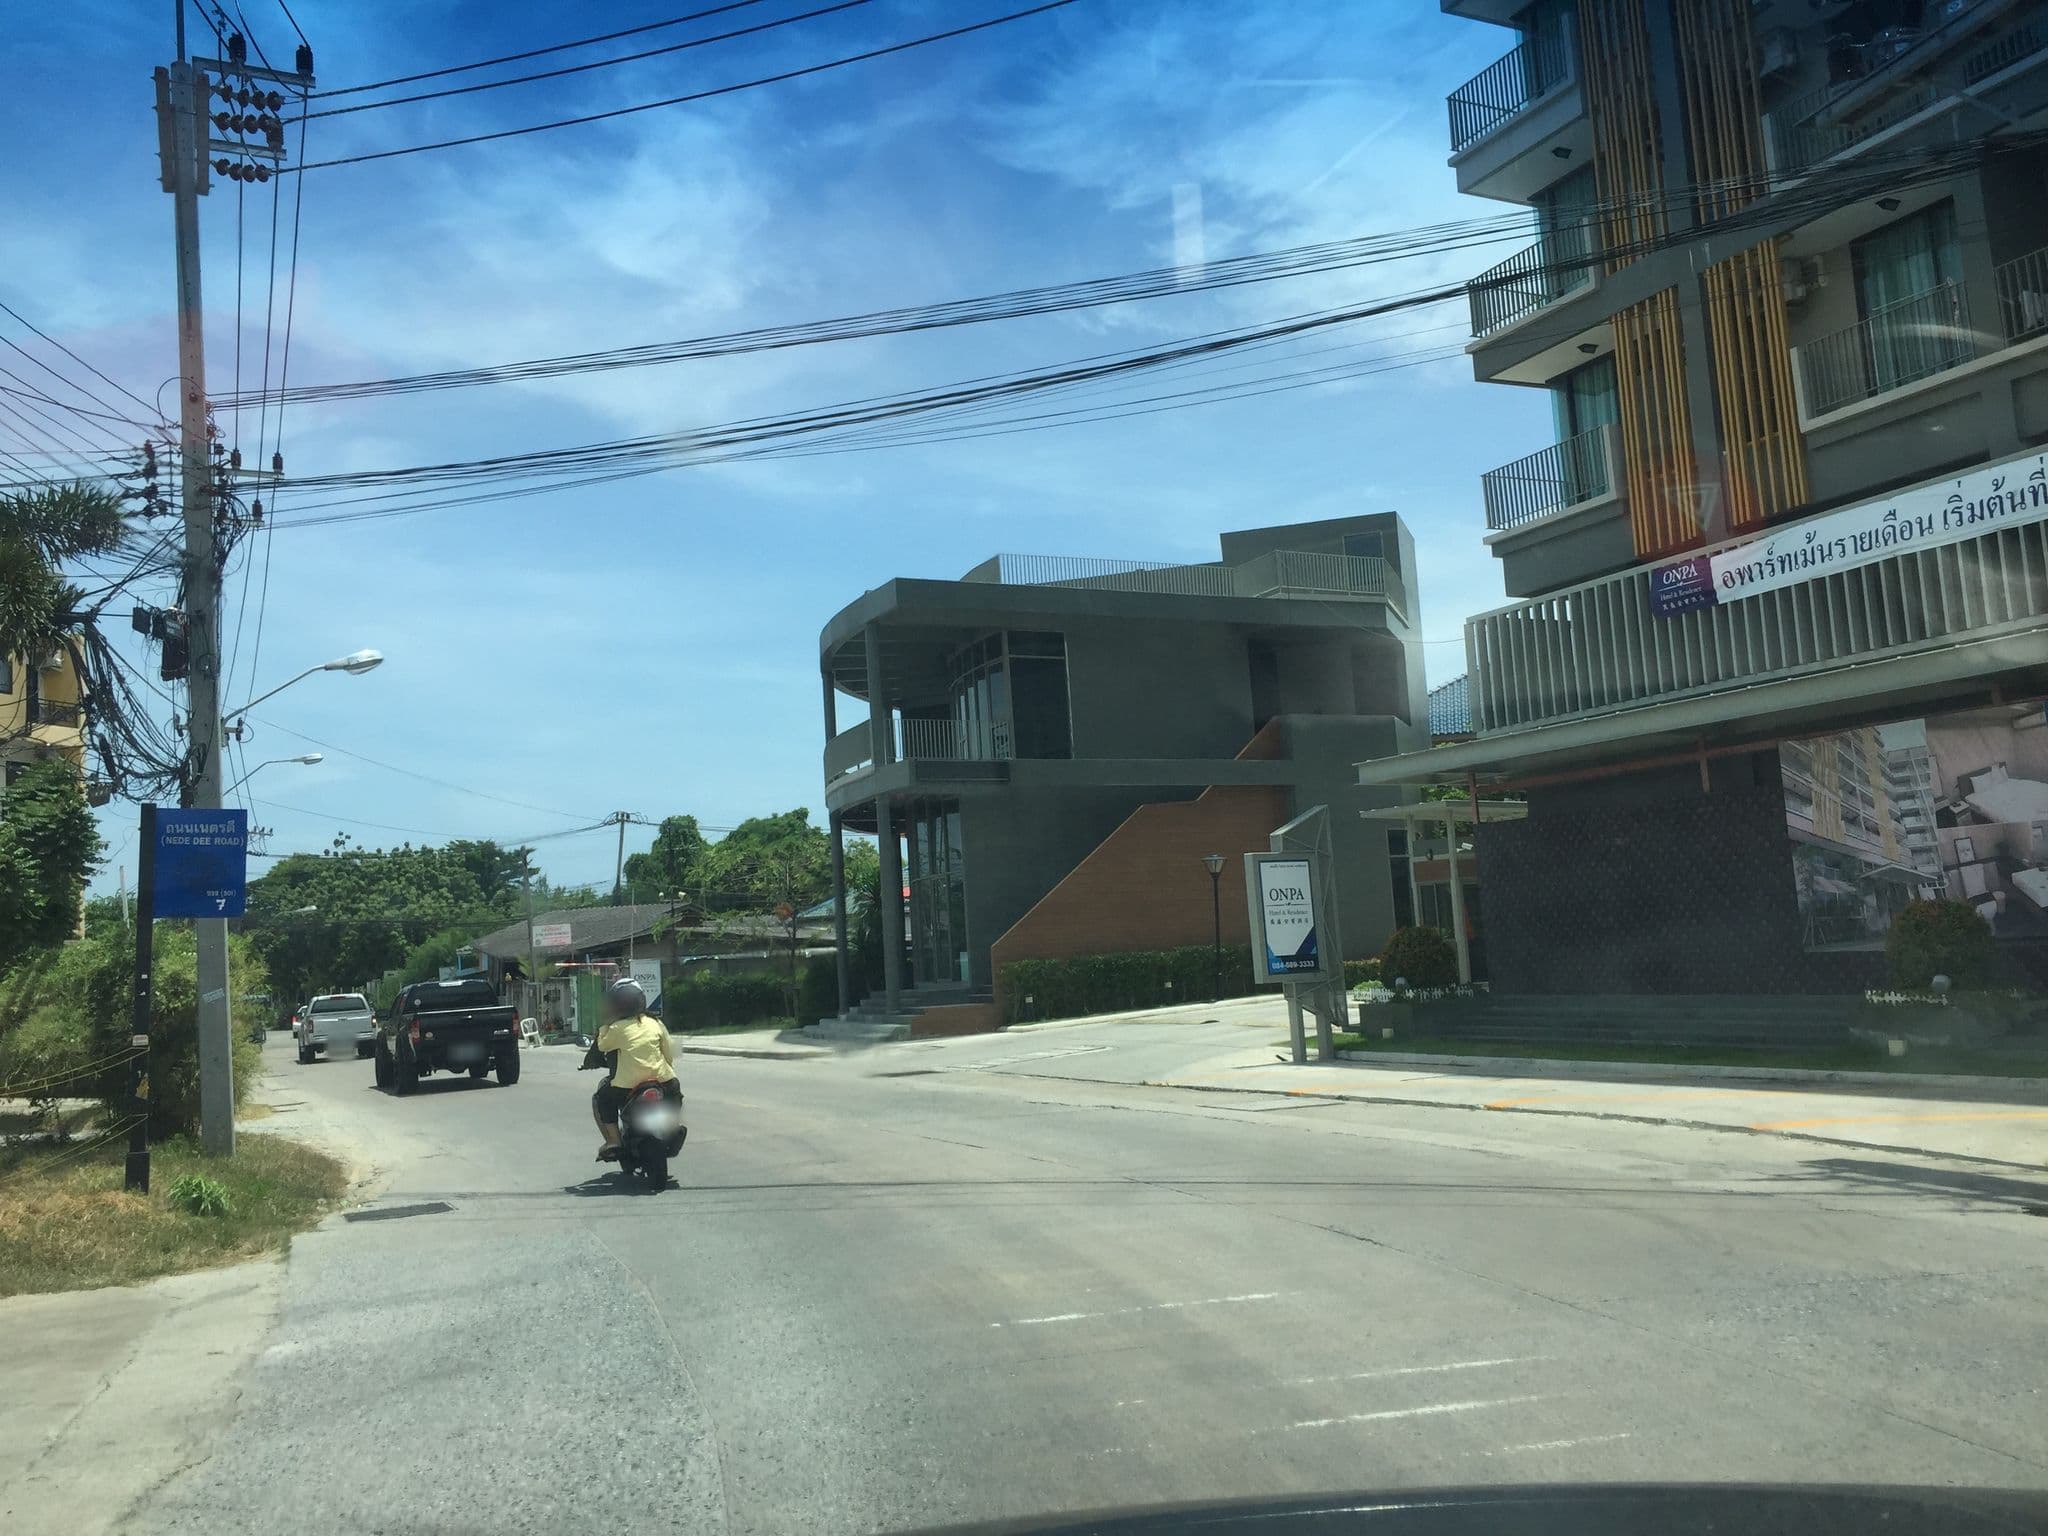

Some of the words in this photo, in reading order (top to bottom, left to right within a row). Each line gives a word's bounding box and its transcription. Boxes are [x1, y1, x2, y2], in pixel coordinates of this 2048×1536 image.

[1721, 508, 1935, 590] อพาร์ทเม้นรายเดือน
[1663, 564, 1698, 584] ONPA
[193, 837, 211, 846] DEE
[214, 837, 244, 847] ROAD)
[1269, 888, 1304, 901] ONPA
[215, 898, 226, 911] 7
